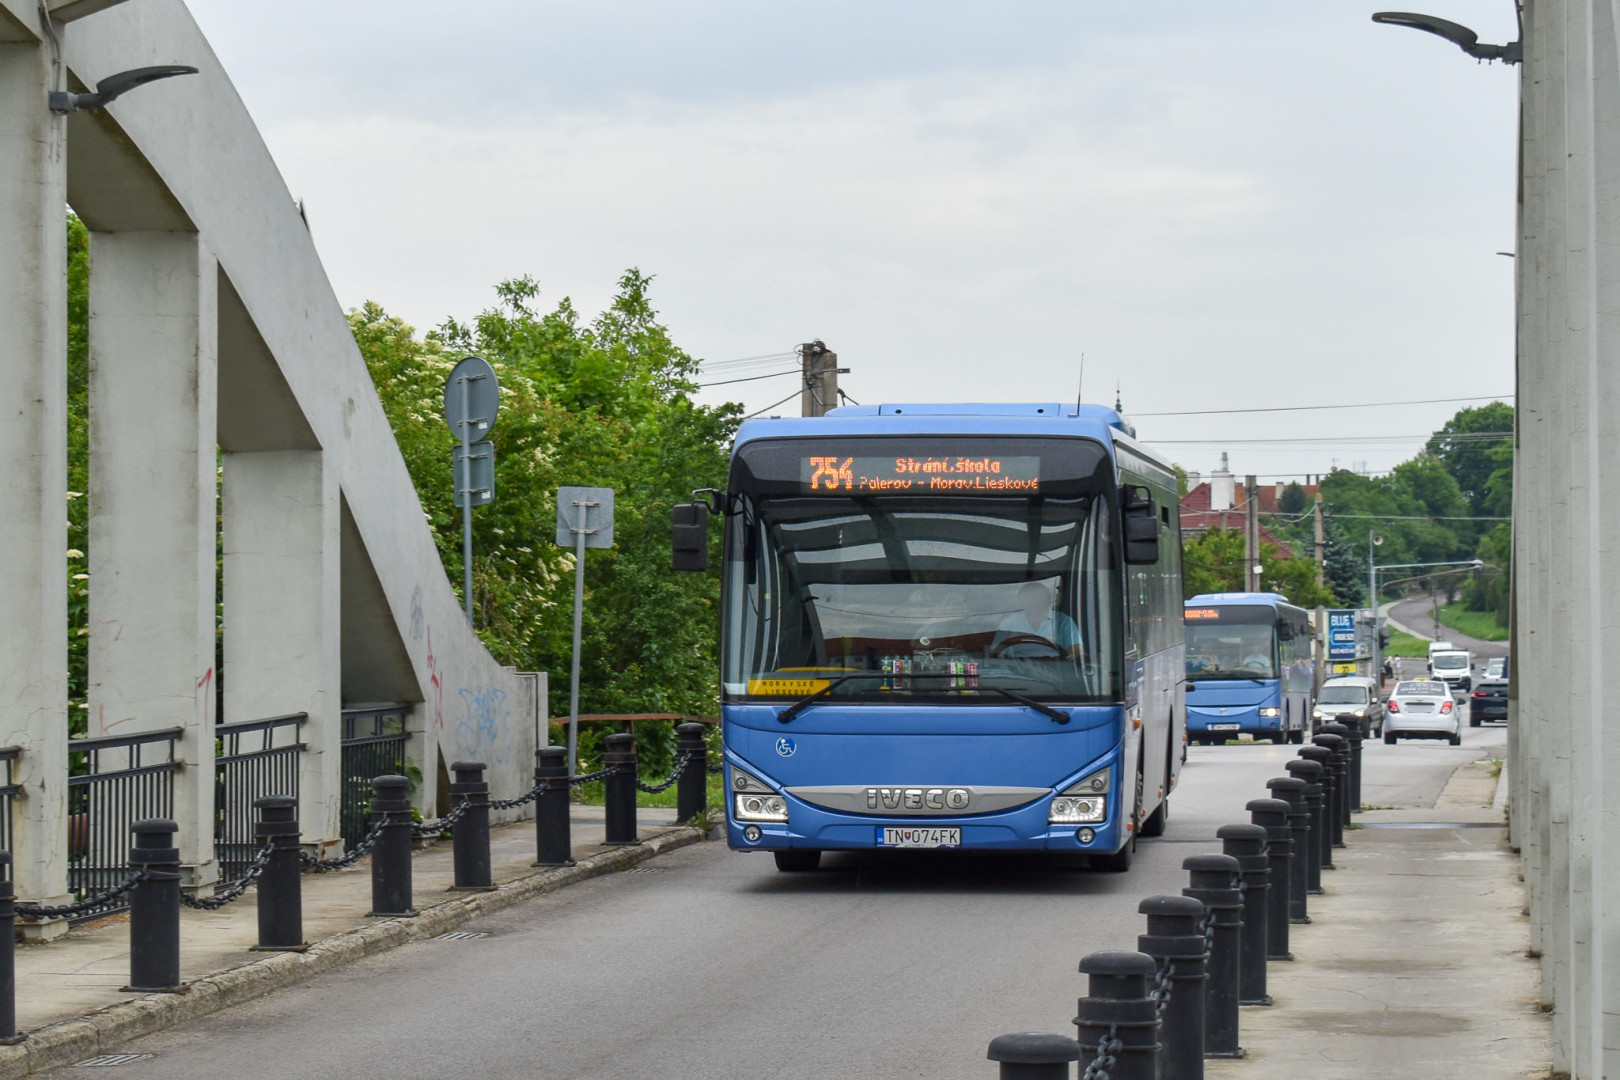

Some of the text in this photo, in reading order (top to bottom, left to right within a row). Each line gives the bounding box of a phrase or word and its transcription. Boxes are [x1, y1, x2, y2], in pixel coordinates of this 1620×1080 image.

[810, 457, 853, 490] 754
[1330, 615, 1350, 626] BLUE
[867, 788, 969, 809] IVECO
